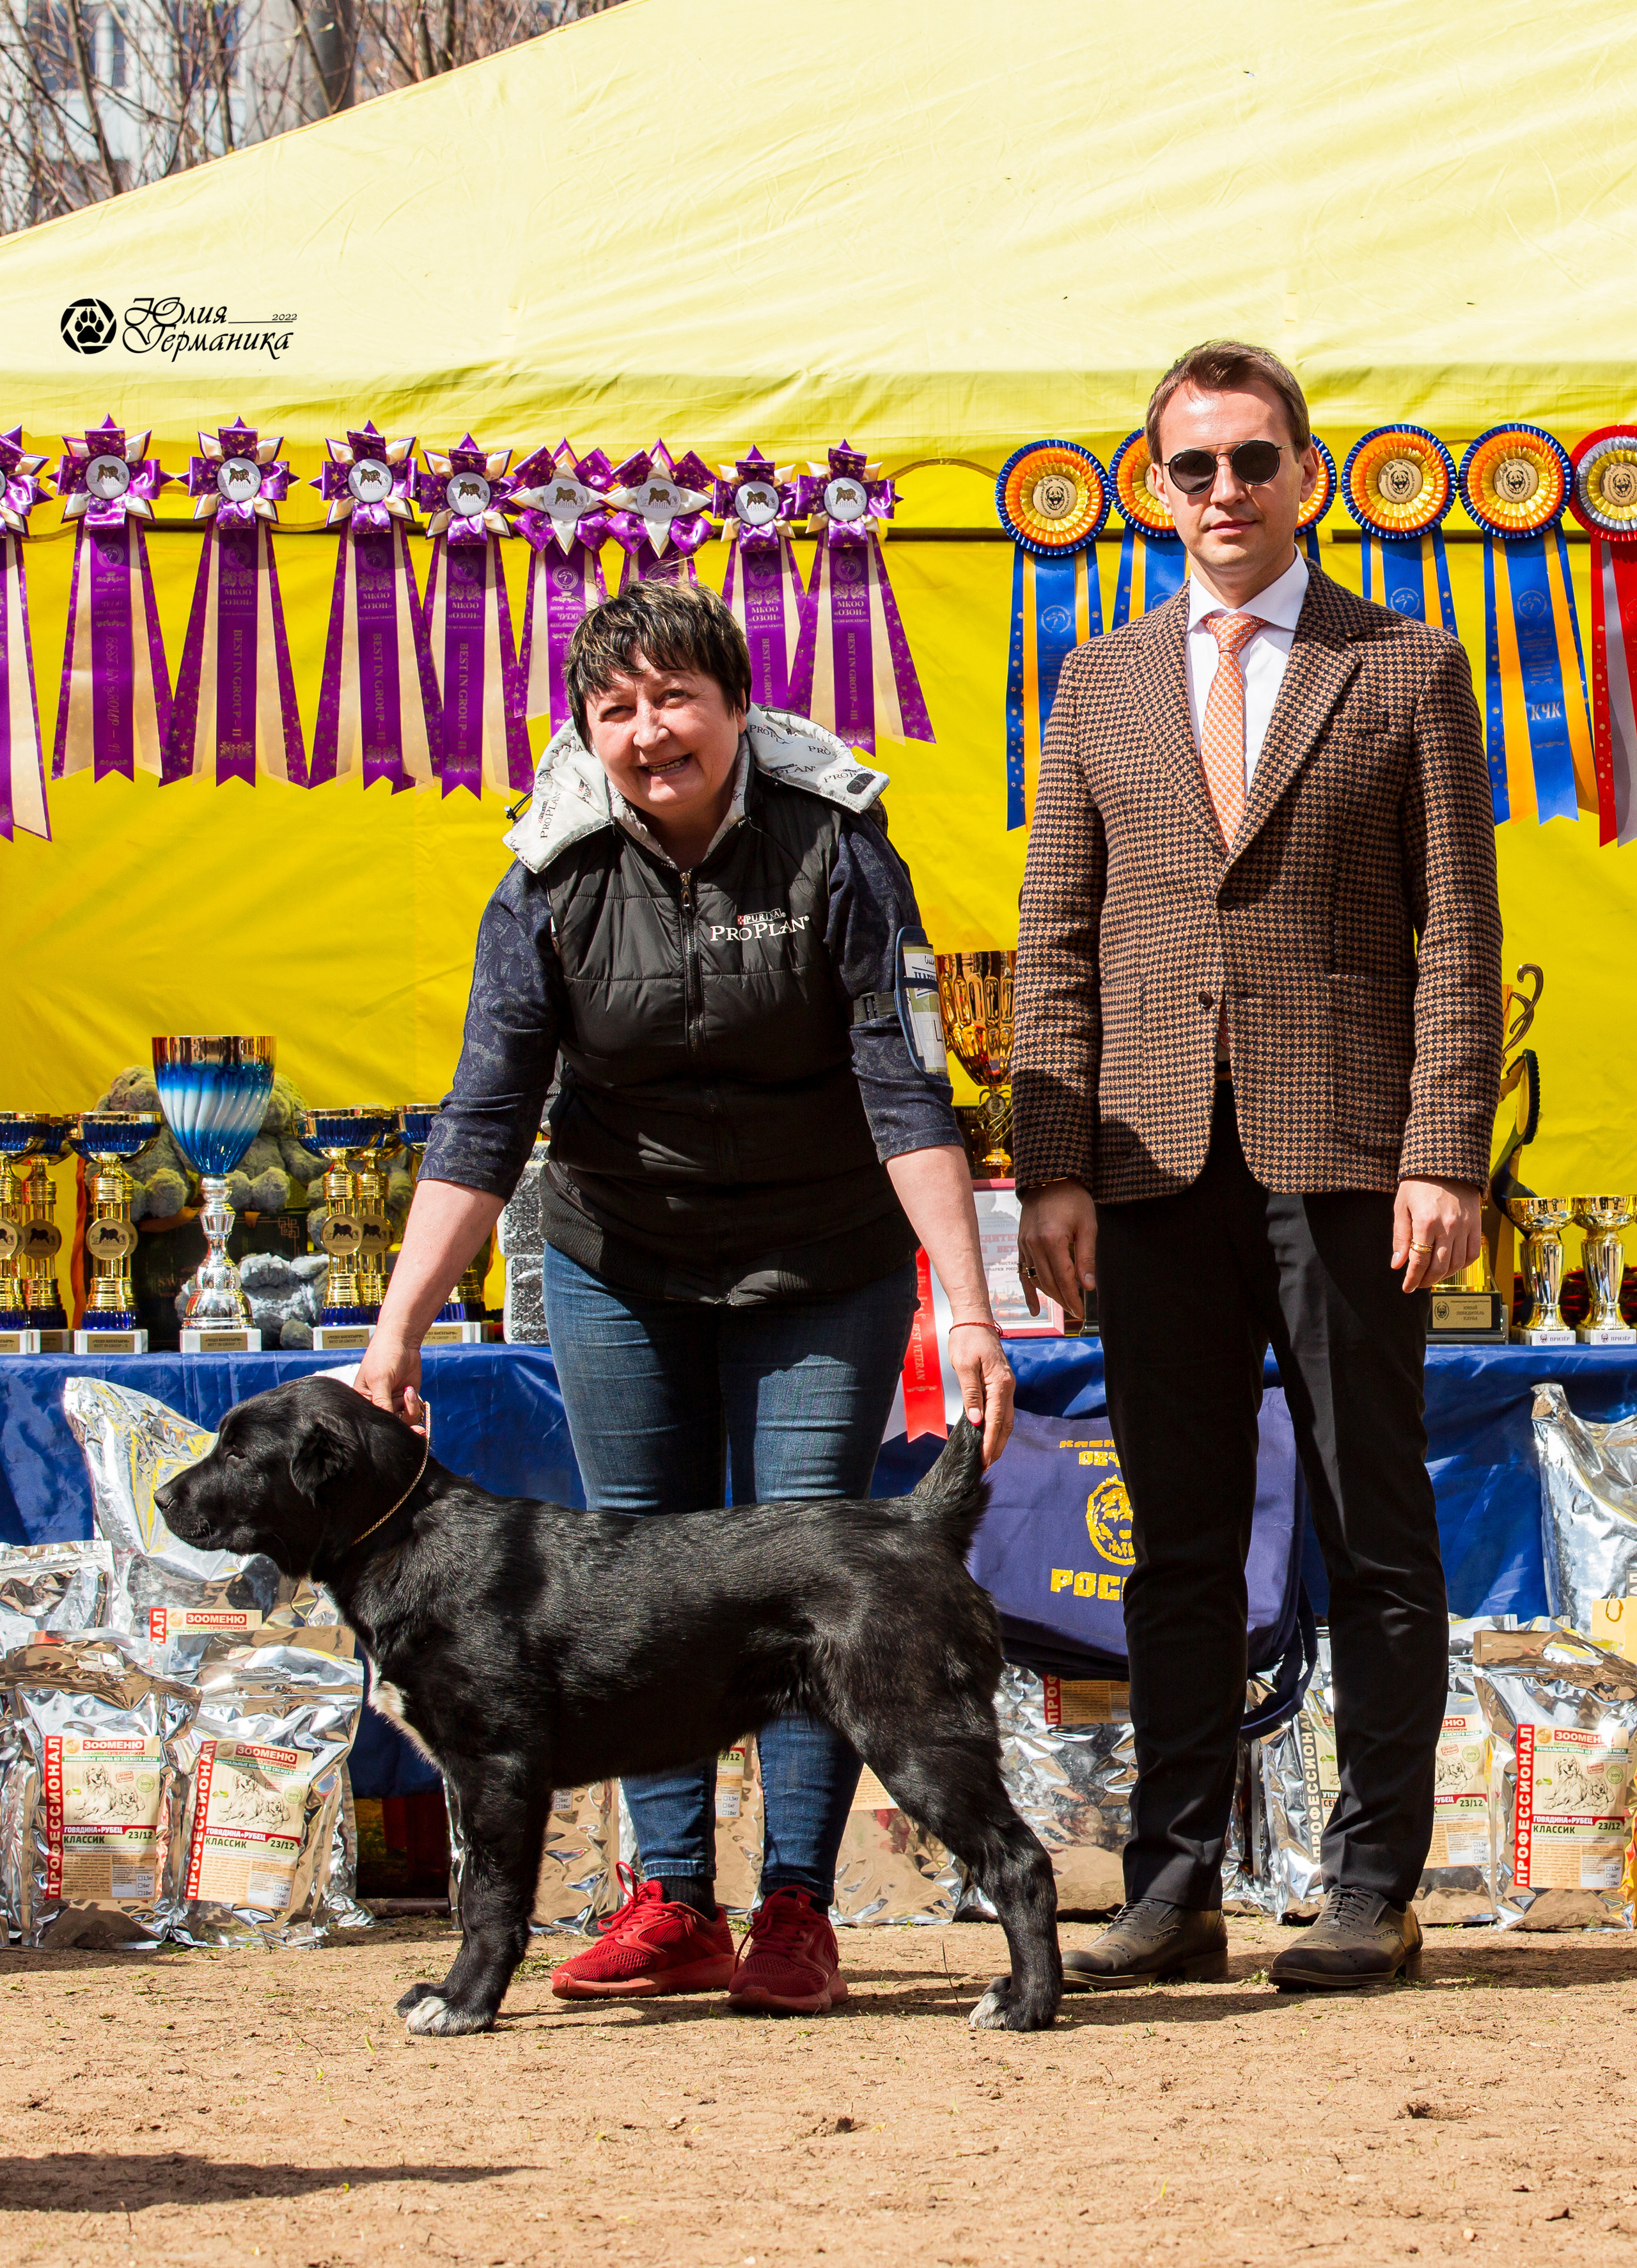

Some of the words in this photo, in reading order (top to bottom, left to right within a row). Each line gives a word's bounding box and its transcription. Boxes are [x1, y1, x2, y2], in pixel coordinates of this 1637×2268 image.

[233, 629, 242, 658] BEST
[372, 633, 383, 661] BEST
[761, 638, 771, 661] BEST
[847, 632, 857, 656] BEST
[458, 643, 469, 672] BEST
[848, 657, 856, 666] IN
[233, 660, 242, 673] IN
[373, 665, 384, 677] IN
[763, 663, 772, 673] IN
[458, 674, 468, 686] IN
[848, 668, 858, 702] GROUP
[232, 676, 242, 718] GROUP
[374, 679, 385, 721] GROUP
[457, 689, 468, 731] GROUP
[1530, 701, 1562, 721] КЧК
[540, 791, 561, 840] PROPLAN
[746, 910, 781, 923] PURINA
[912, 1344, 926, 1380] VETERAN
[187, 1614, 246, 1624] ЗООМЕНЮ
[84, 1741, 143, 1749] ЗООМЕНЮ
[237, 1747, 296, 1763] ЗООМЕНЮ
[1460, 1799, 1483, 1807] 23/12
[1516, 1728, 1532, 1884] ПРОФЕССИОНАЛ
[48, 1738, 61, 1895] ПРОФЕССИОНАЛ
[187, 1742, 214, 1896] ПРОФЕССИОНАЛ
[1533, 1815, 1594, 1825] ГОВЯДИНА+РУБЕЦ
[64, 1826, 123, 1834] ГОВЯДИНА+РУБЕЦ
[1533, 1825, 1576, 1834] КЛАССИК
[1598, 1822, 1621, 1831] 23/12
[128, 1831, 153, 1839] 23/12
[206, 1827, 266, 1841] ГОВЯДИНА+РУБЕЦ
[205, 1837, 247, 1848] КЛАССИК
[270, 1839, 295, 1850] 23/12
